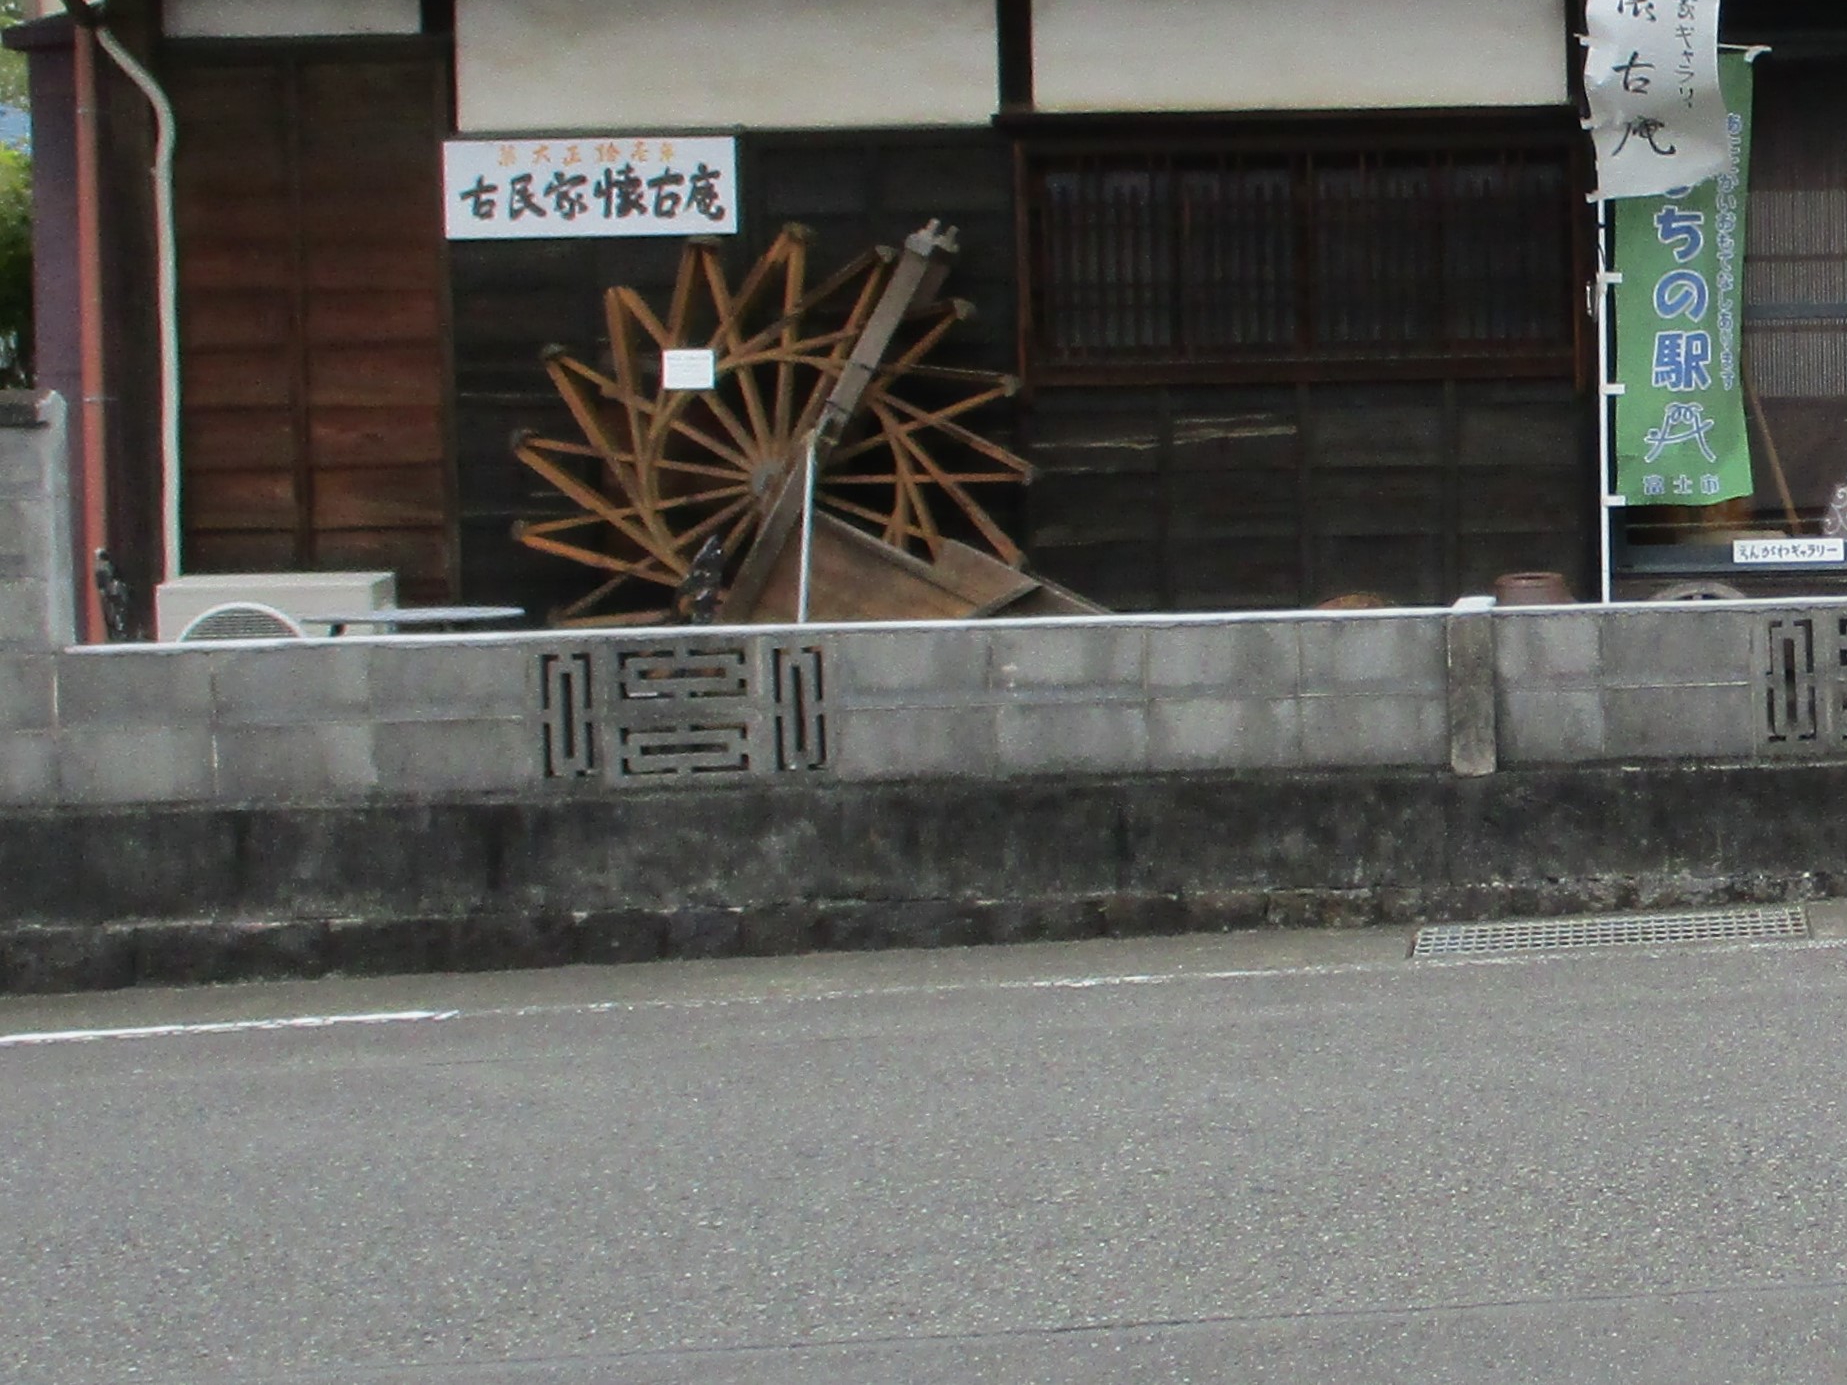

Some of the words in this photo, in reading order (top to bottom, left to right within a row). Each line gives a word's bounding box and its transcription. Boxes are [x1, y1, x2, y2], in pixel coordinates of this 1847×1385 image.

[459, 162, 726, 221] 古民家懐古庵
[1643, 474, 1721, 495] 富士市
[1739, 543, 1838, 561] えんがわギャラリー
